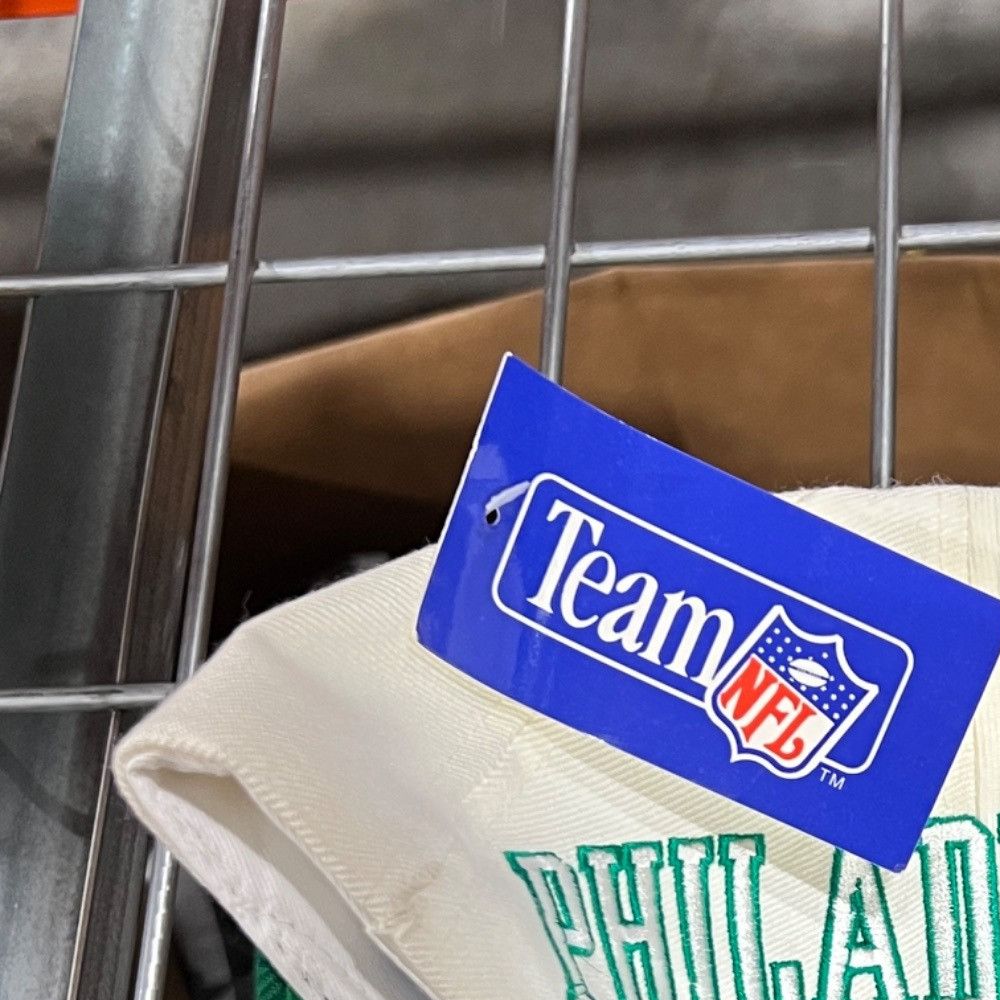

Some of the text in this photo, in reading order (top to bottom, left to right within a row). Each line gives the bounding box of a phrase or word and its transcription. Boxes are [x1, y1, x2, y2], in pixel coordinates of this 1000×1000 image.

[527, 499, 736, 689] Team
[719, 654, 806, 762] NFL
[818, 767, 846, 791] TM
